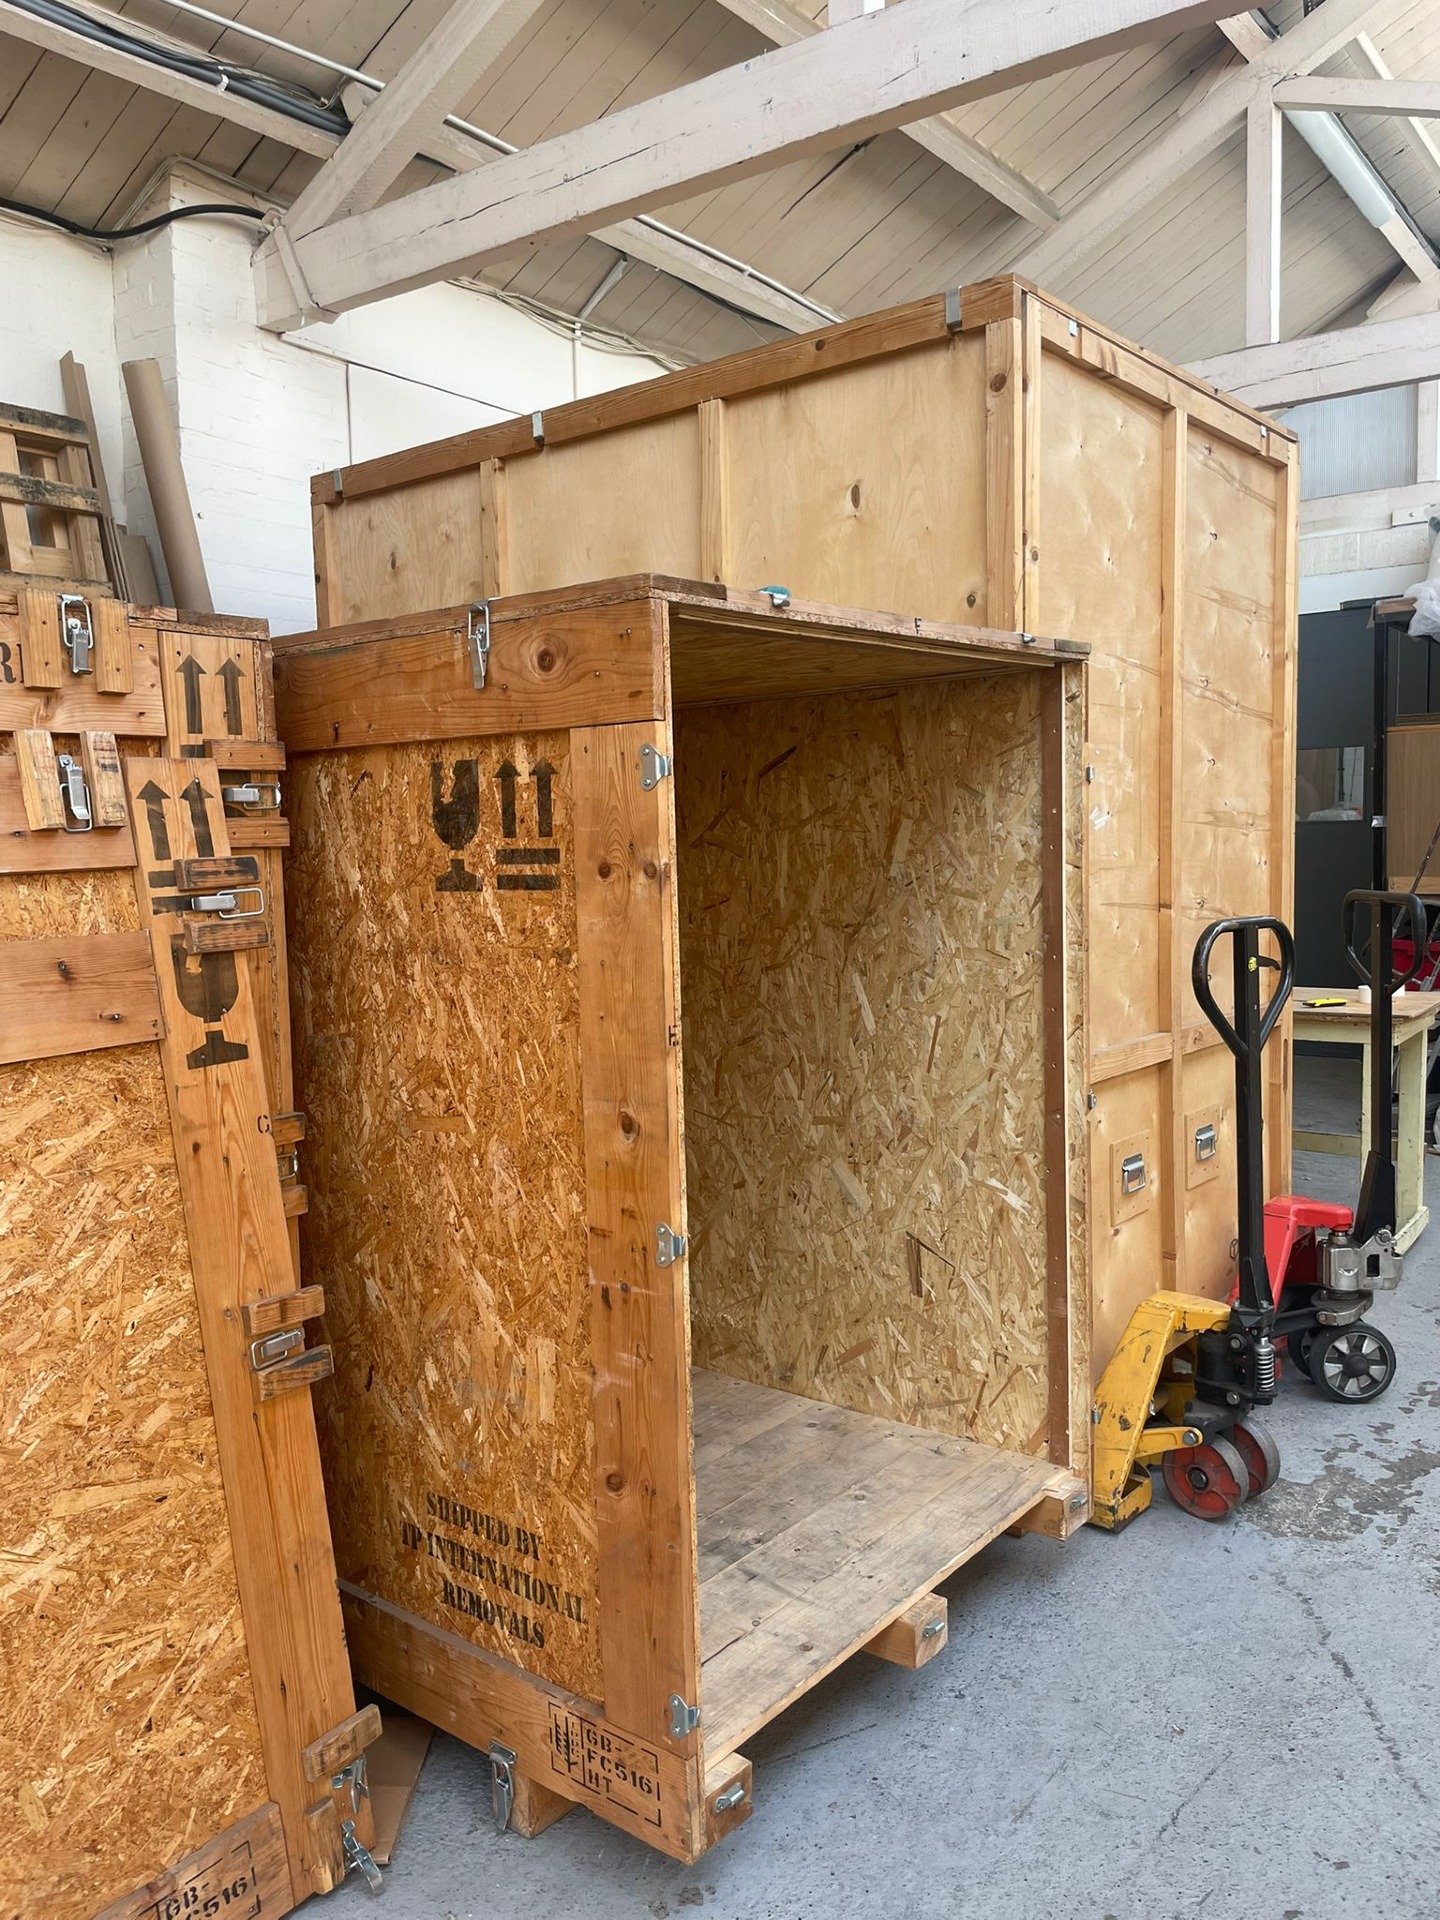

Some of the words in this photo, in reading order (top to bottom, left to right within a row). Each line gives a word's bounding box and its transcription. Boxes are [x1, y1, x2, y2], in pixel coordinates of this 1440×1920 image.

[427, 1491, 510, 1546] SHIPPED
[515, 1526, 543, 1561] BY
[426, 1531, 587, 1623] INTERNATIONAL
[442, 1577, 546, 1649] REMOVALS
[587, 1748, 653, 1795] FC516
[588, 1768, 613, 1793] HT
